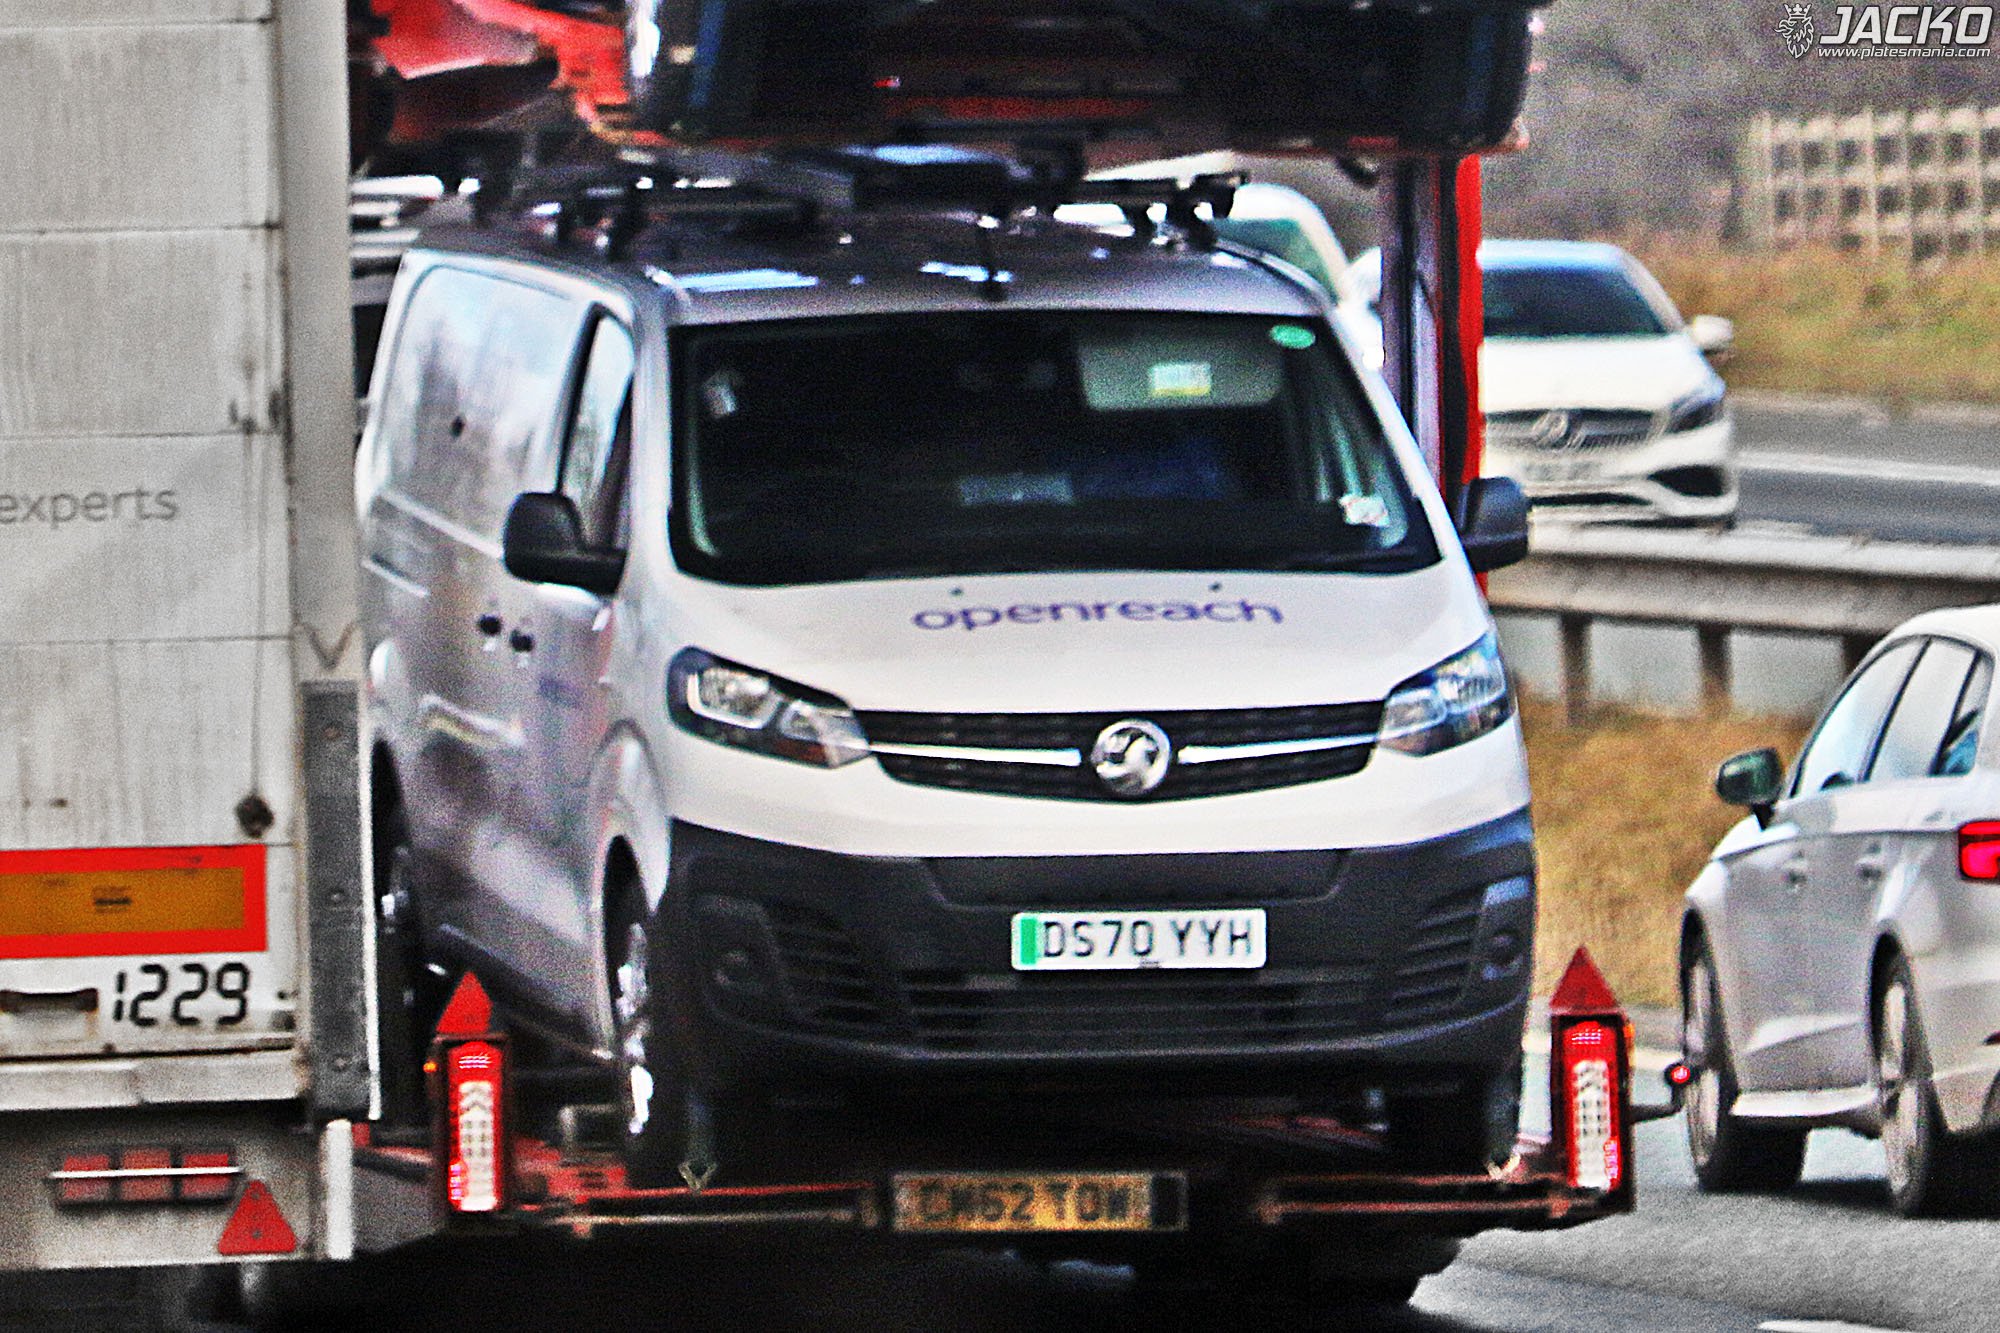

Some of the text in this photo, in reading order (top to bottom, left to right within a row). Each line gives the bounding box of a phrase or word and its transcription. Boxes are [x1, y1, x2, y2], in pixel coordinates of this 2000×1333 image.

[0, 484, 180, 530] experts
[912, 599, 1283, 631] openreach
[1042, 918, 1251, 958] DS70 YYH
[113, 962, 250, 1027] 1229
